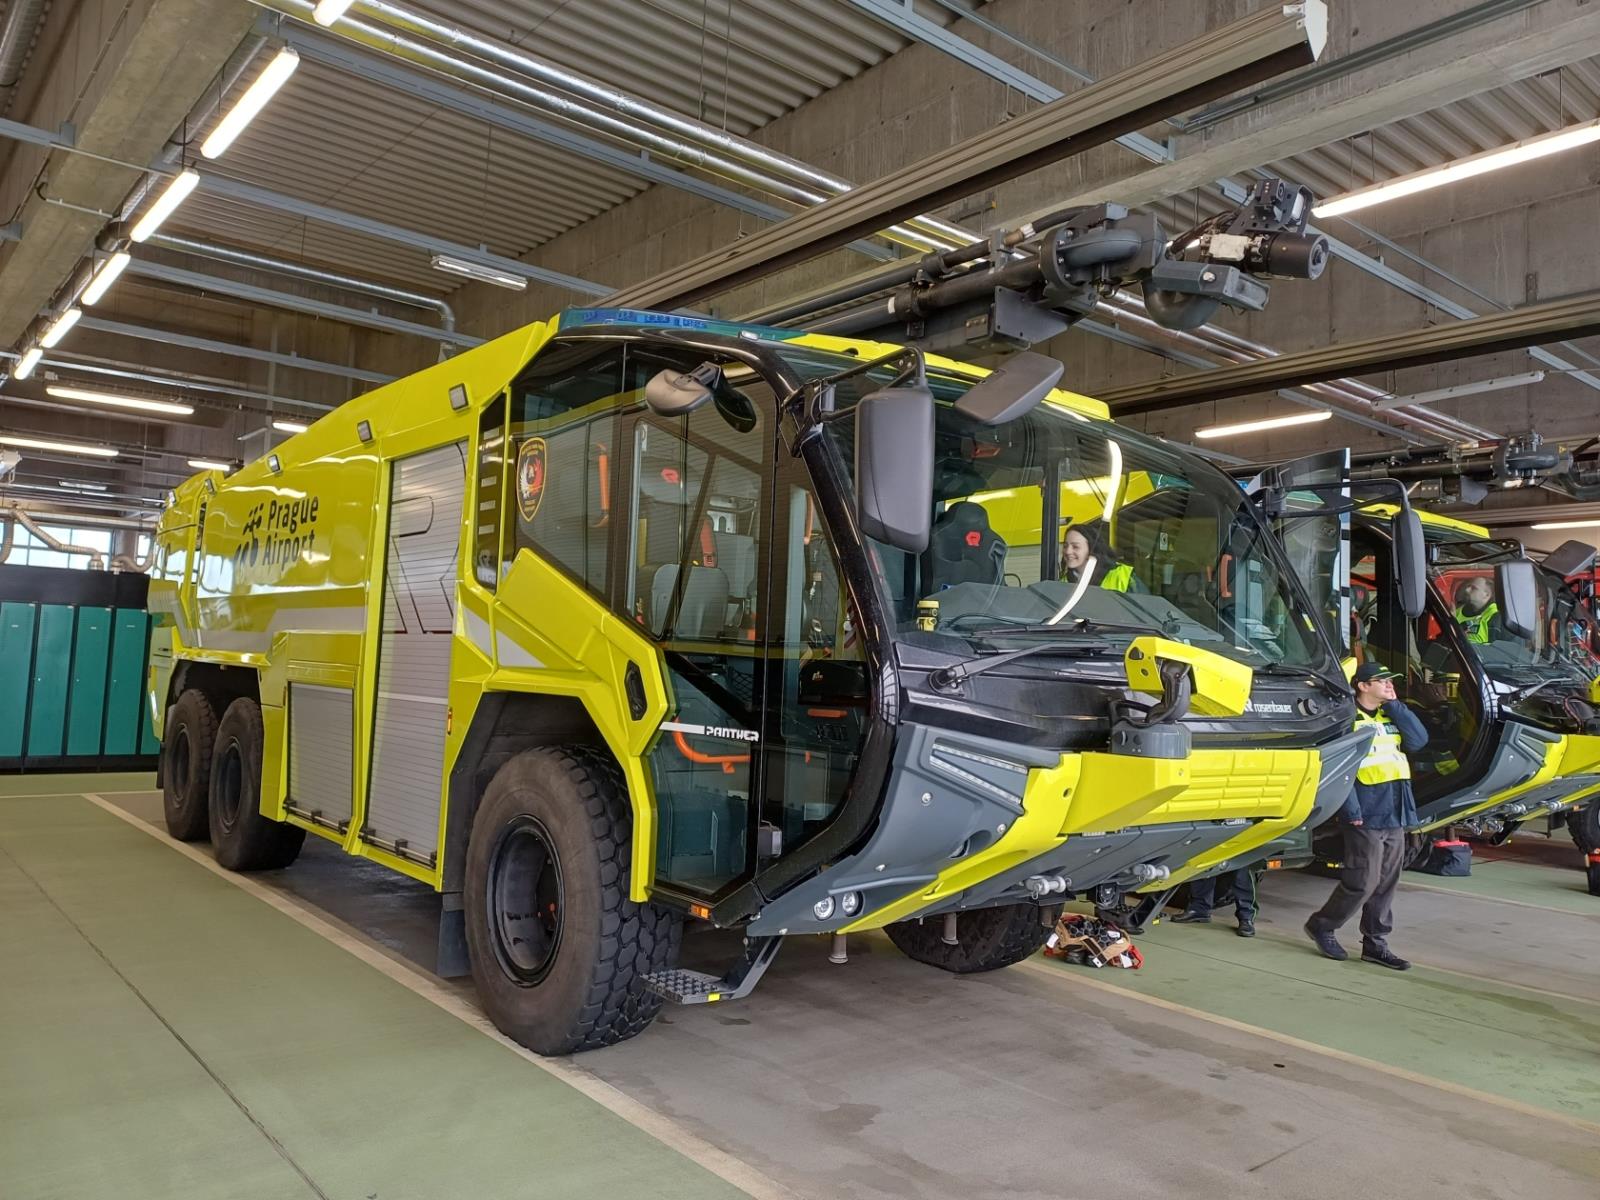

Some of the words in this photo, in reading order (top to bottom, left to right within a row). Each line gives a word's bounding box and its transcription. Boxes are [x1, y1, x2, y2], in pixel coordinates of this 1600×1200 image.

[267, 496, 319, 534] Prague
[262, 529, 315, 571] Airport
[1253, 700, 1293, 713] rosenbauer
[706, 725, 760, 742] PANTHER
